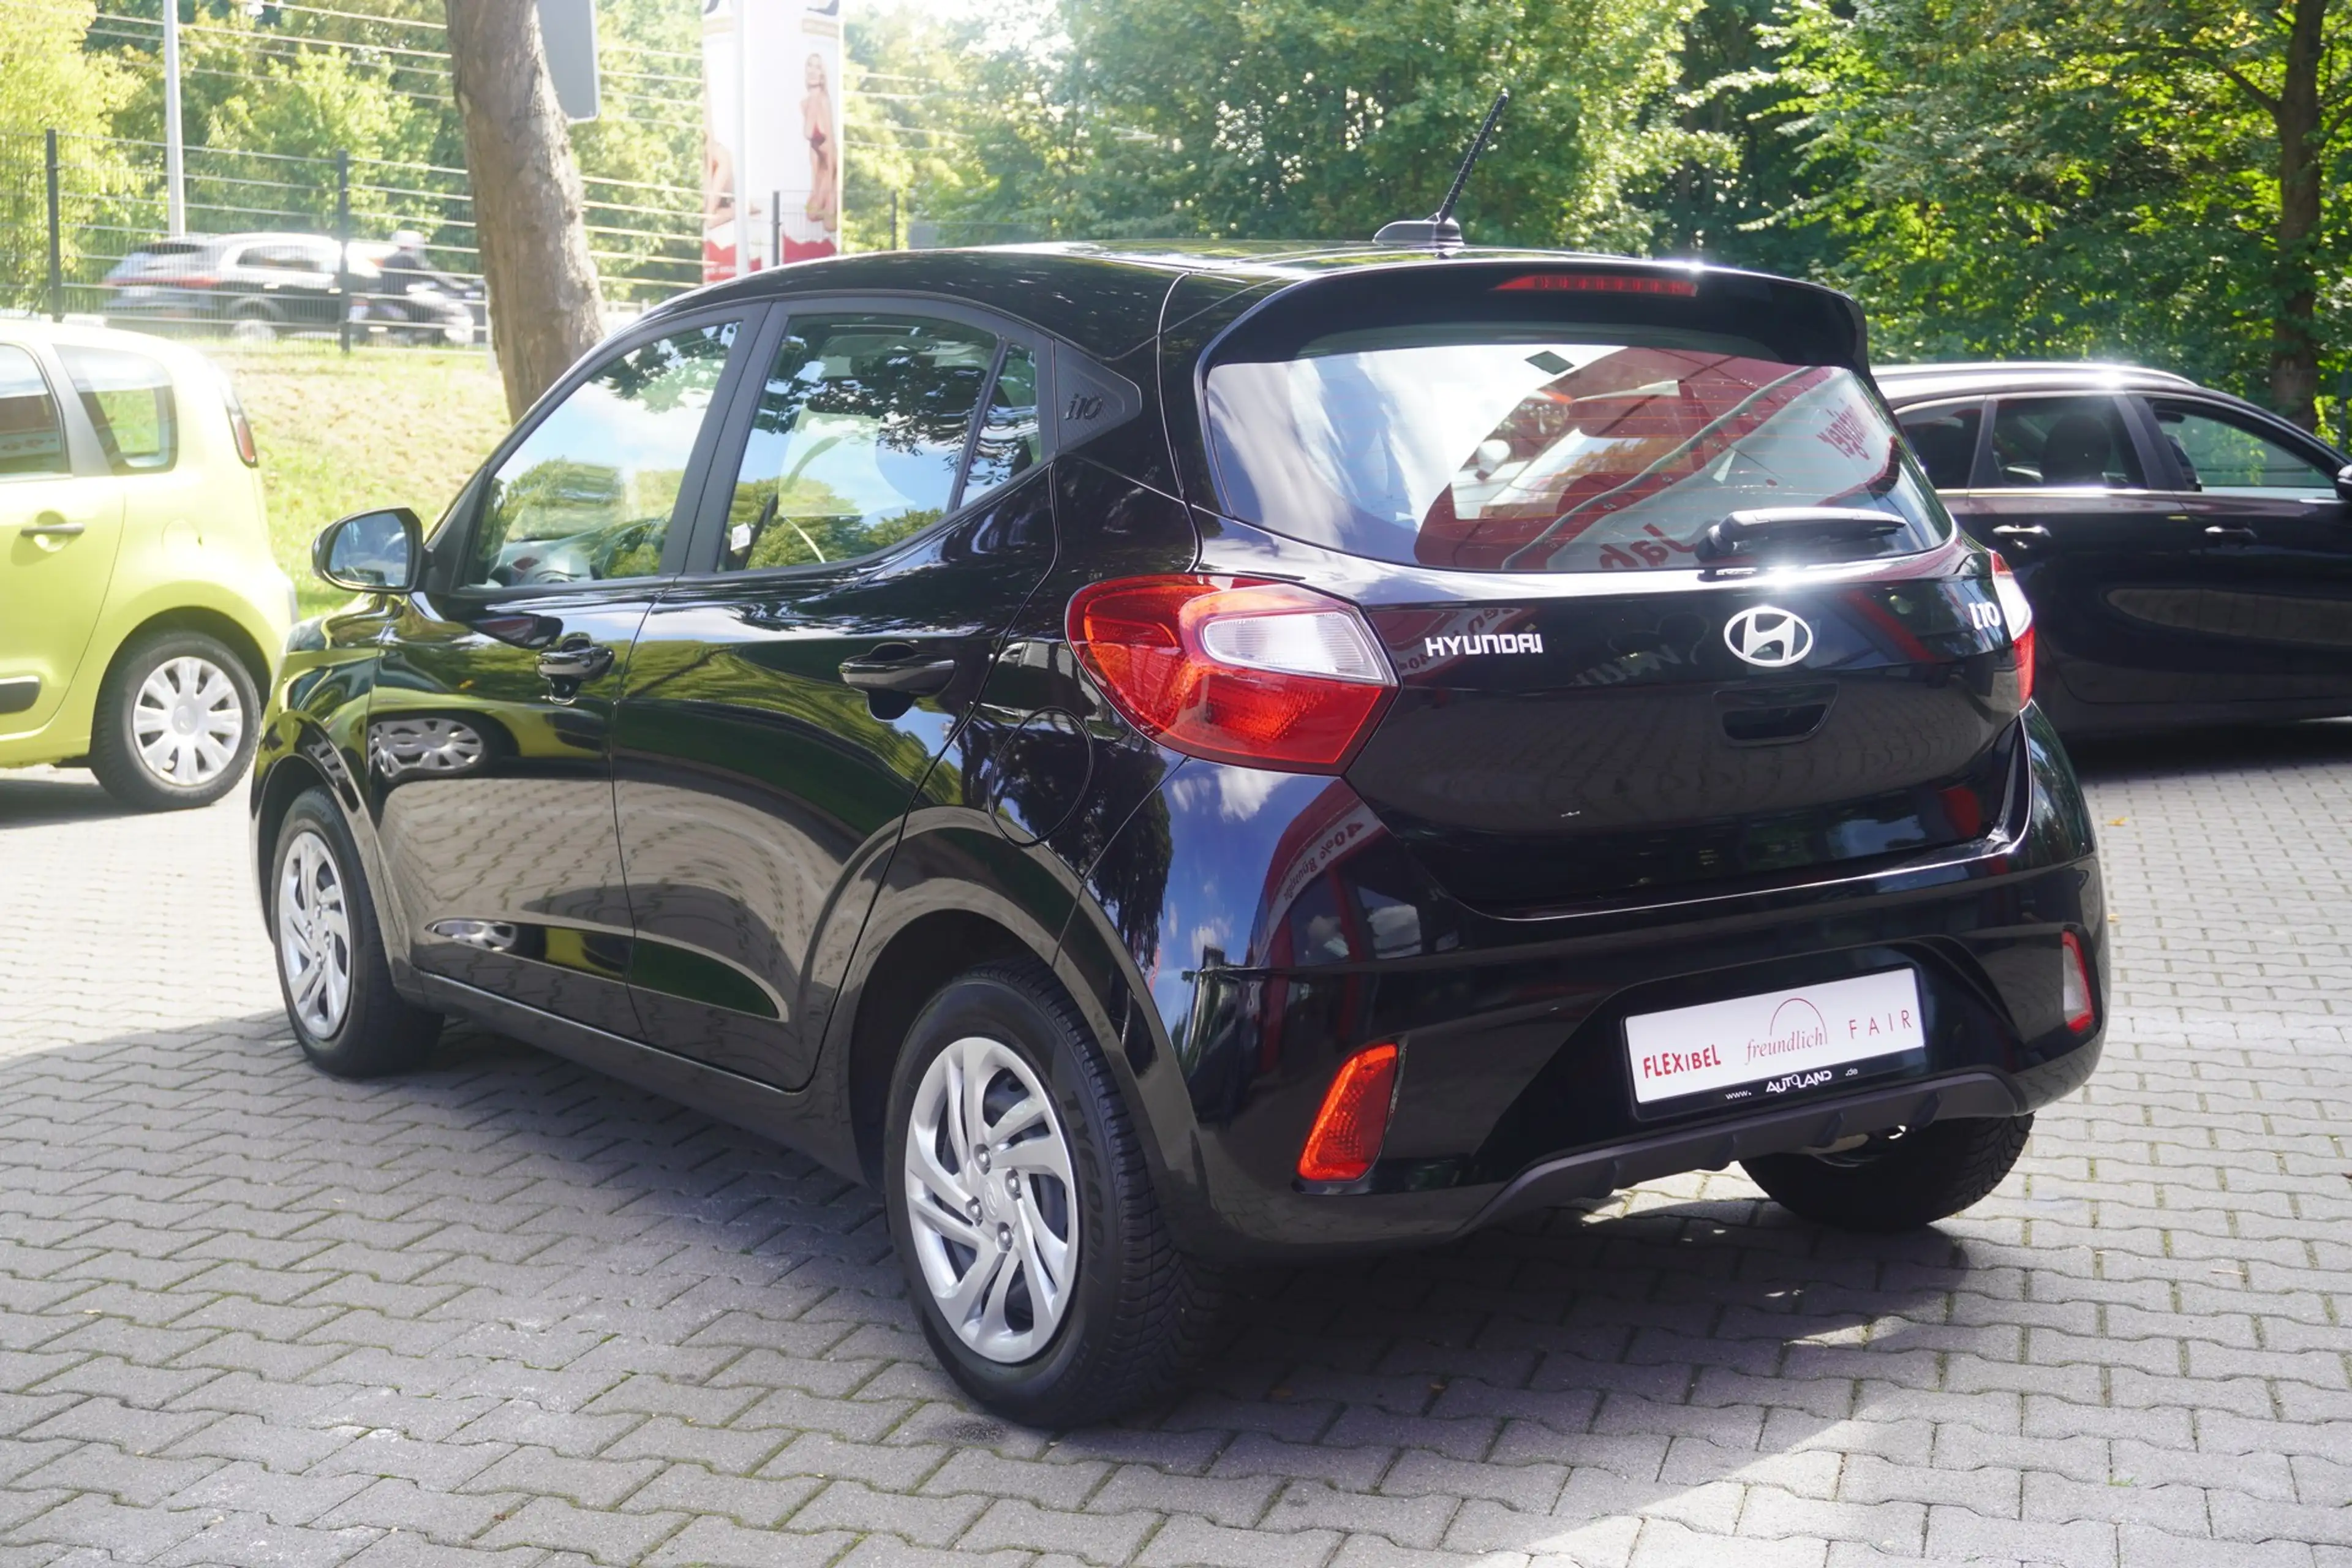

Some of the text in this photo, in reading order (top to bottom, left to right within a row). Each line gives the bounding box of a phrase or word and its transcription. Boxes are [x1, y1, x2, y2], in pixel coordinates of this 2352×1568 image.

[1425, 633, 1544, 657] HYUNDAI
[1643, 1009, 1912, 1079] FLEXIBEL freundlich FAIR
[1766, 1070, 1833, 1093] AUTOLAND
